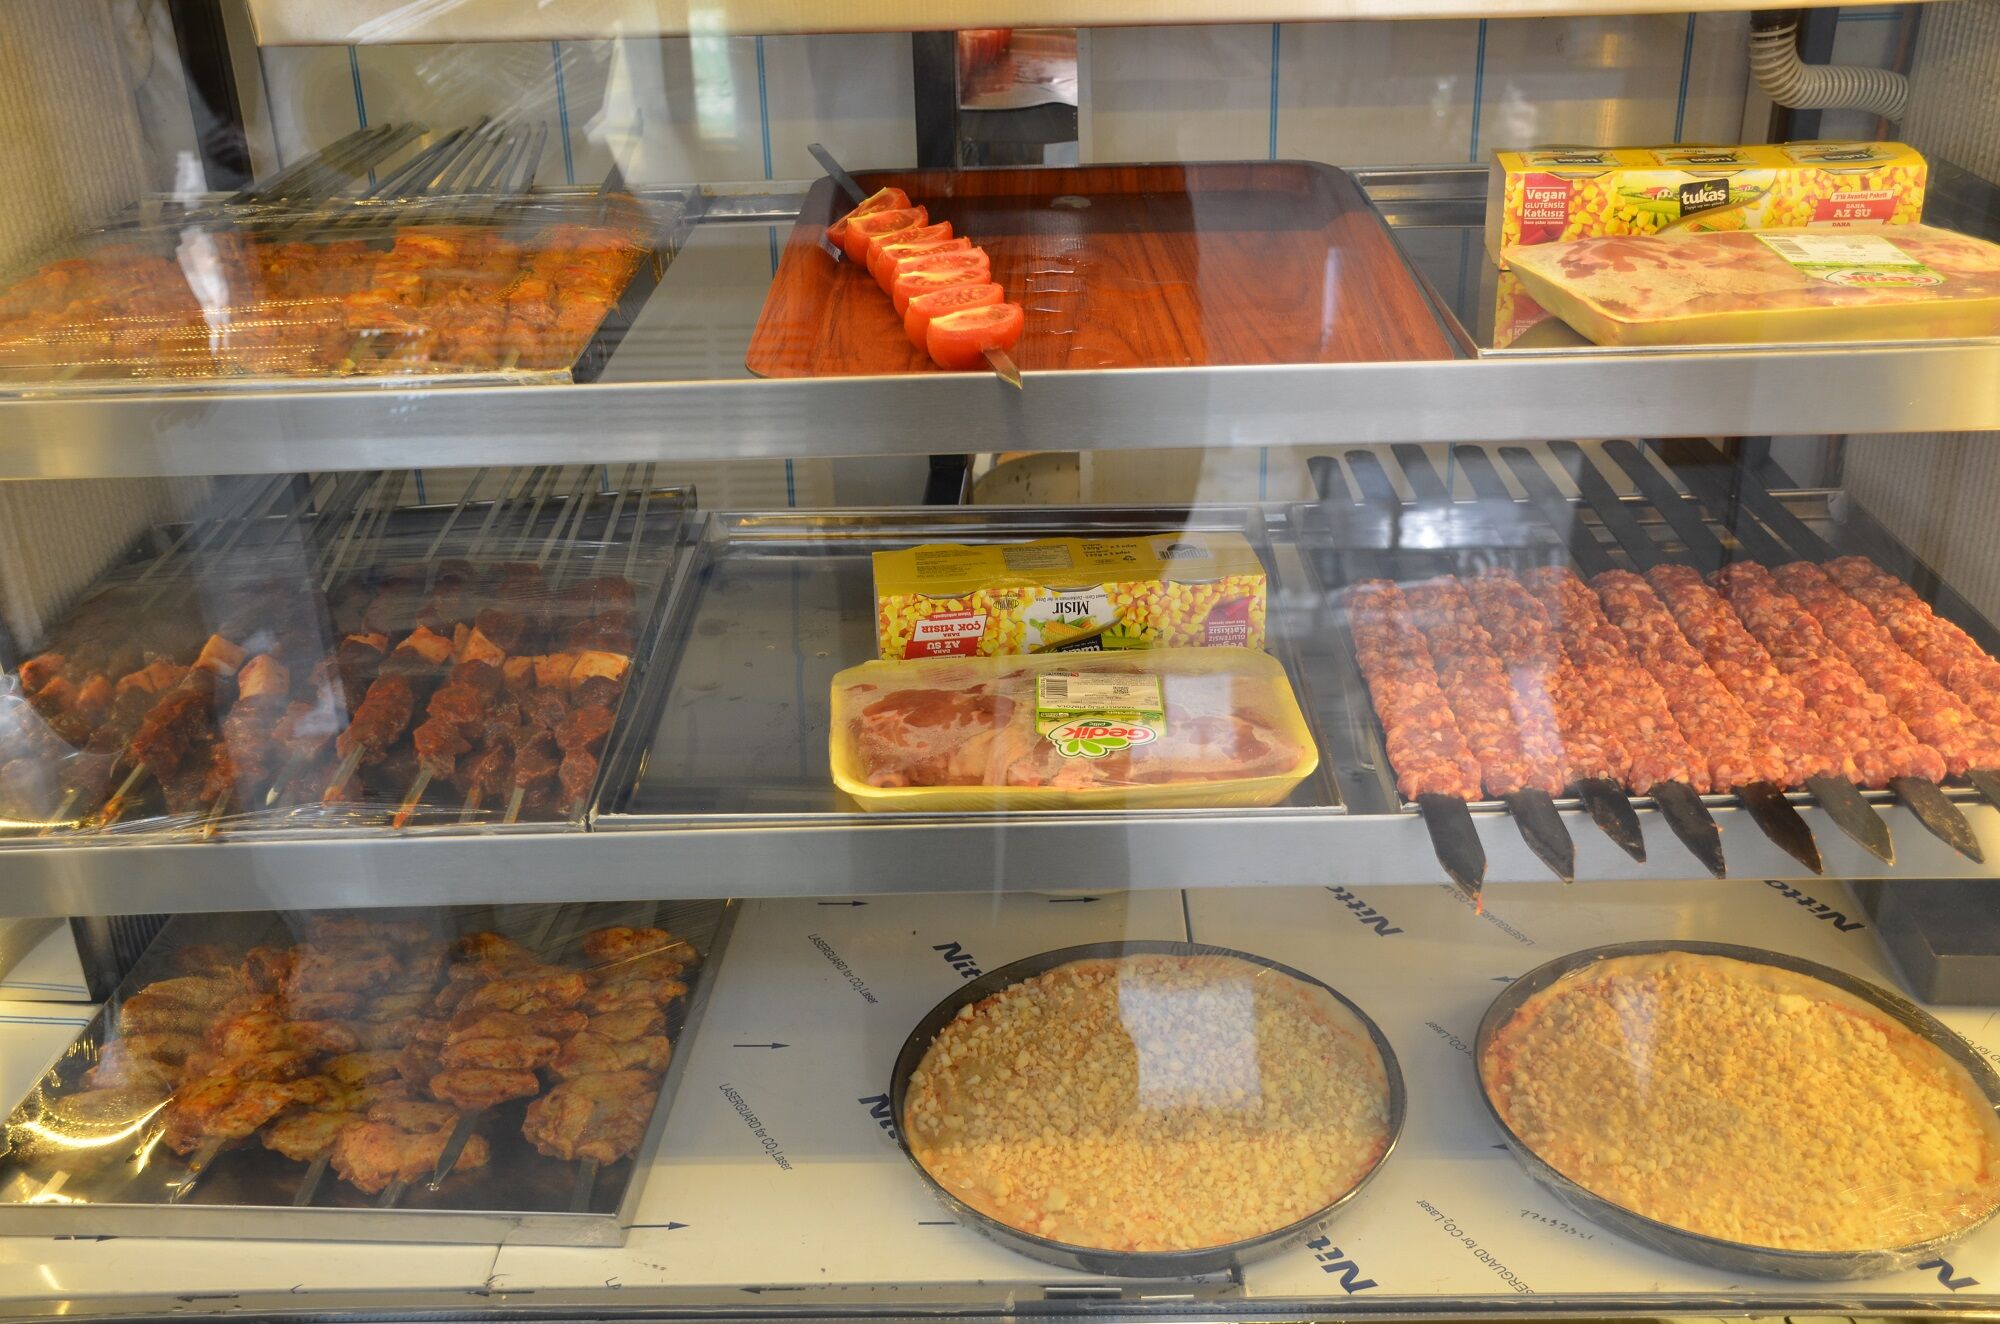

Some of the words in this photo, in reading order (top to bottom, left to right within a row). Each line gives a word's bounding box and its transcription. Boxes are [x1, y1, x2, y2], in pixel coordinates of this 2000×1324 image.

[1526, 189, 1567, 202] Vegan
[1681, 188, 1726, 205] tukaş
[1524, 209, 1565, 218] Katkısız
[1833, 209, 1851, 218] AZ
[1855, 208, 1872, 218] SU
[921, 624, 955, 634] MISIR
[957, 620, 981, 631] ÇOK
[1208, 626, 1246, 635] Katkısız
[926, 642, 942, 650] SU
[944, 640, 961, 649] AZ
[1062, 726, 1150, 741] Gedik
[1763, 880, 1865, 933] Nitto
[932, 941, 983, 978] Nit
[808, 933, 848, 971] LASERGUARD
[841, 969, 854, 978] for
[859, 987, 879, 1004] Laser
[1425, 1022, 1450, 1039] Laser
[719, 1082, 762, 1129] LASERGUARD
[753, 1127, 767, 1138] for
[772, 1150, 793, 1171] Laser
[1415, 1200, 1445, 1222] Laser
[1460, 1236, 1477, 1250] for
[1305, 1235, 1379, 1295] Nit
[1473, 1247, 1536, 1294] SERGUARD
